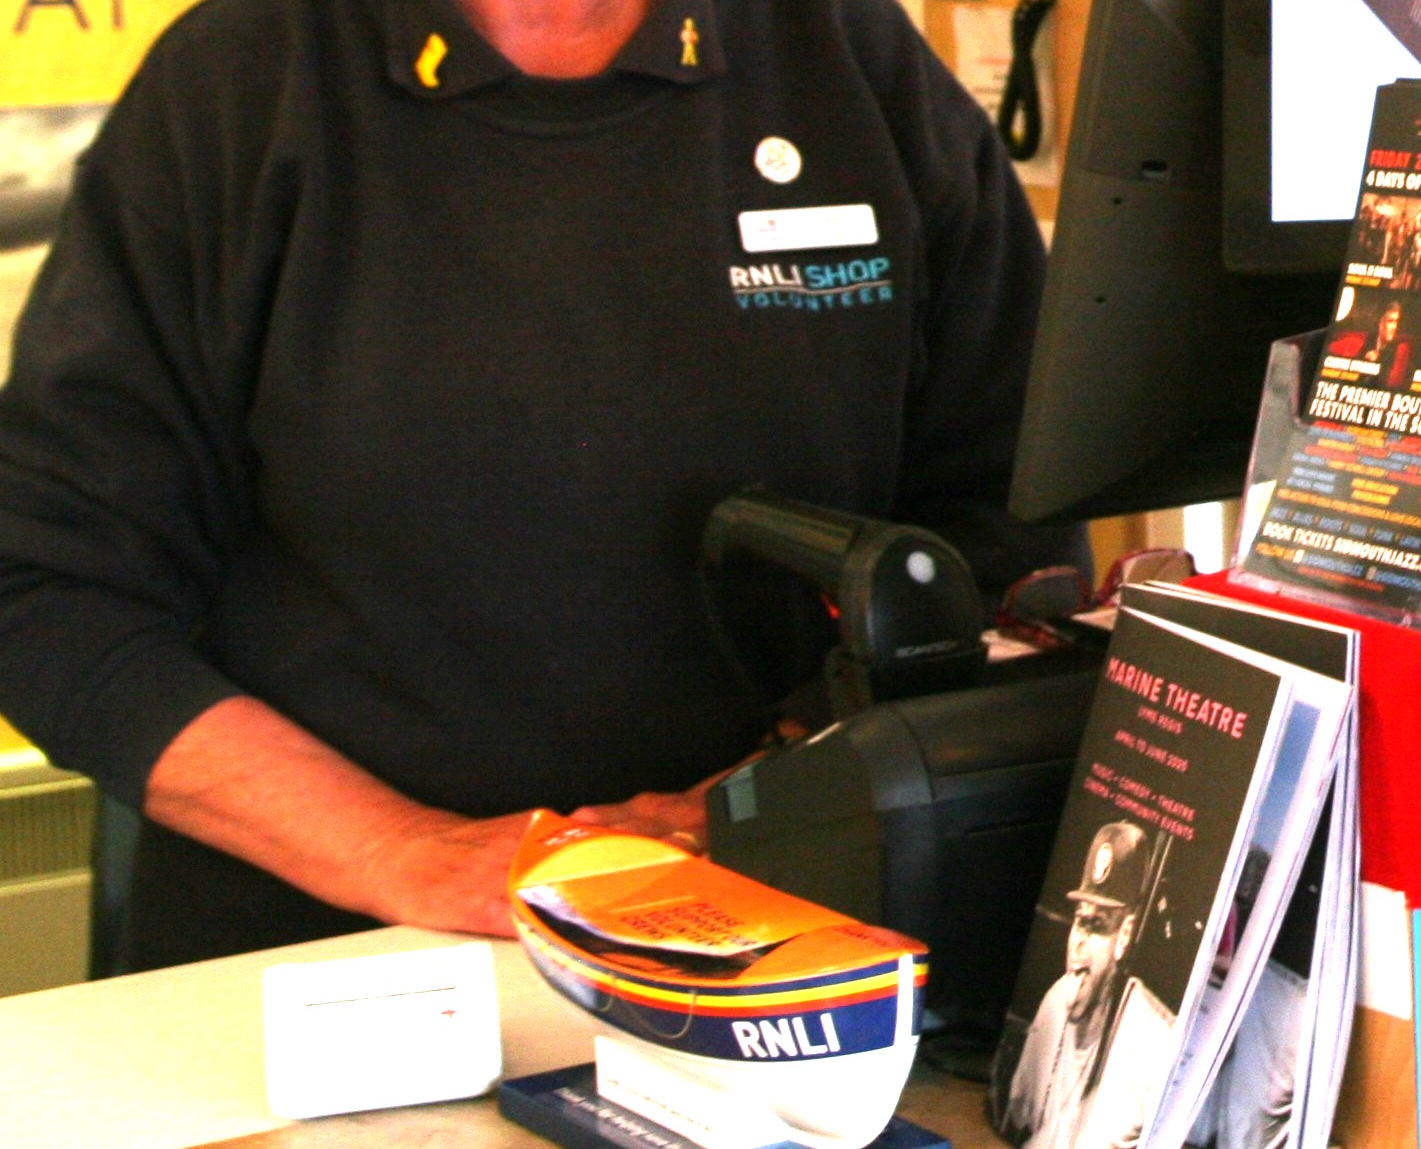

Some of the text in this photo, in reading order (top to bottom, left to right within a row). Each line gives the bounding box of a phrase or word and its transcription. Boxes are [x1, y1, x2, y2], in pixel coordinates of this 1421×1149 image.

[1369, 149, 1413, 168] FRIDAY
[1365, 169, 1376, 187] 4
[1375, 170, 1405, 189] DAYS
[729, 257, 890, 289] RNLI SHOP
[735, 284, 894, 312] VOLUNTEER
[1316, 381, 1340, 399] THE
[1339, 384, 1389, 408] PREMIER
[1309, 398, 1364, 424] FESTIVAL
[1366, 407, 1382, 427] IN
[1383, 408, 1408, 432] THE
[1262, 521, 1294, 539] BOOK
[1293, 527, 1335, 551] TICKETS
[1105, 656, 1249, 740] MARINE THEATRE
[1114, 728, 1137, 750] APRIL
[1119, 775, 1153, 800] COMEDY
[1157, 793, 1197, 823] THEATRE
[1114, 792, 1162, 826] COMMUNITY
[1160, 814, 1197, 842] EVENTS
[731, 1012, 842, 1060] RNLI
